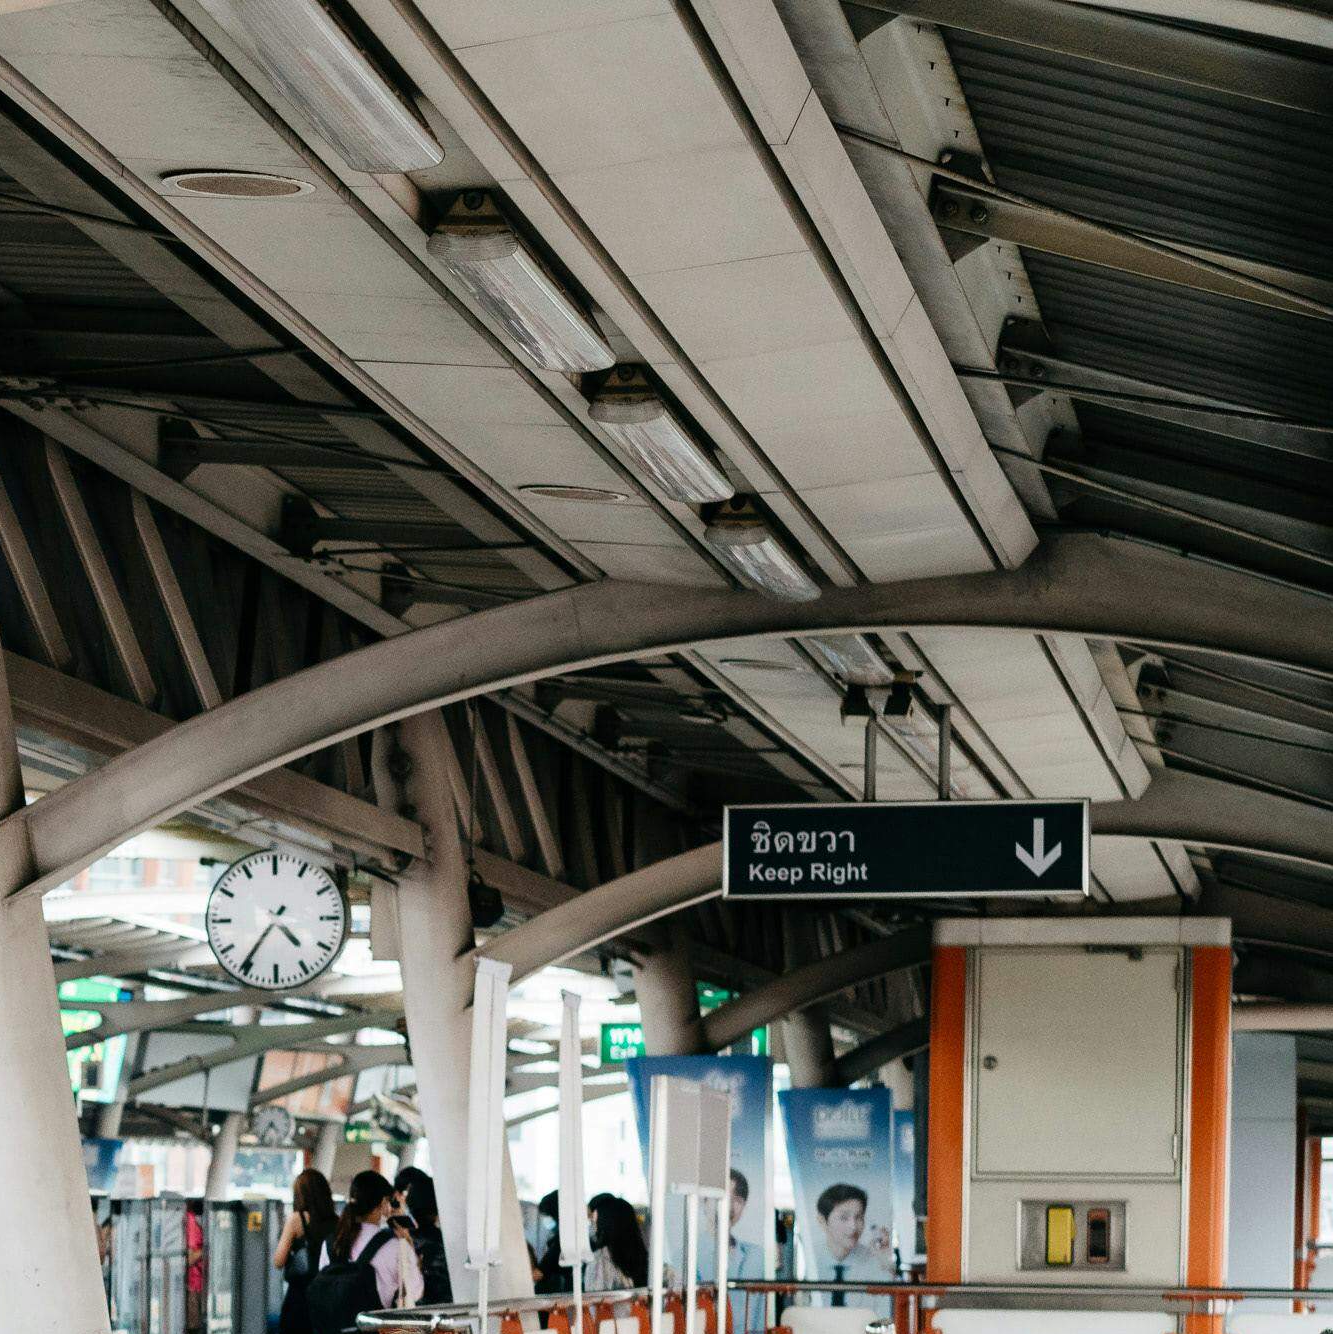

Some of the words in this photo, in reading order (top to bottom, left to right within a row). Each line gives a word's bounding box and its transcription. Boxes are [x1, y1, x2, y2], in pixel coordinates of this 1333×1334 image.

[751, 820, 855, 854] ชิดขวา
[749, 864, 803, 885] Keep
[810, 862, 868, 886] Right
